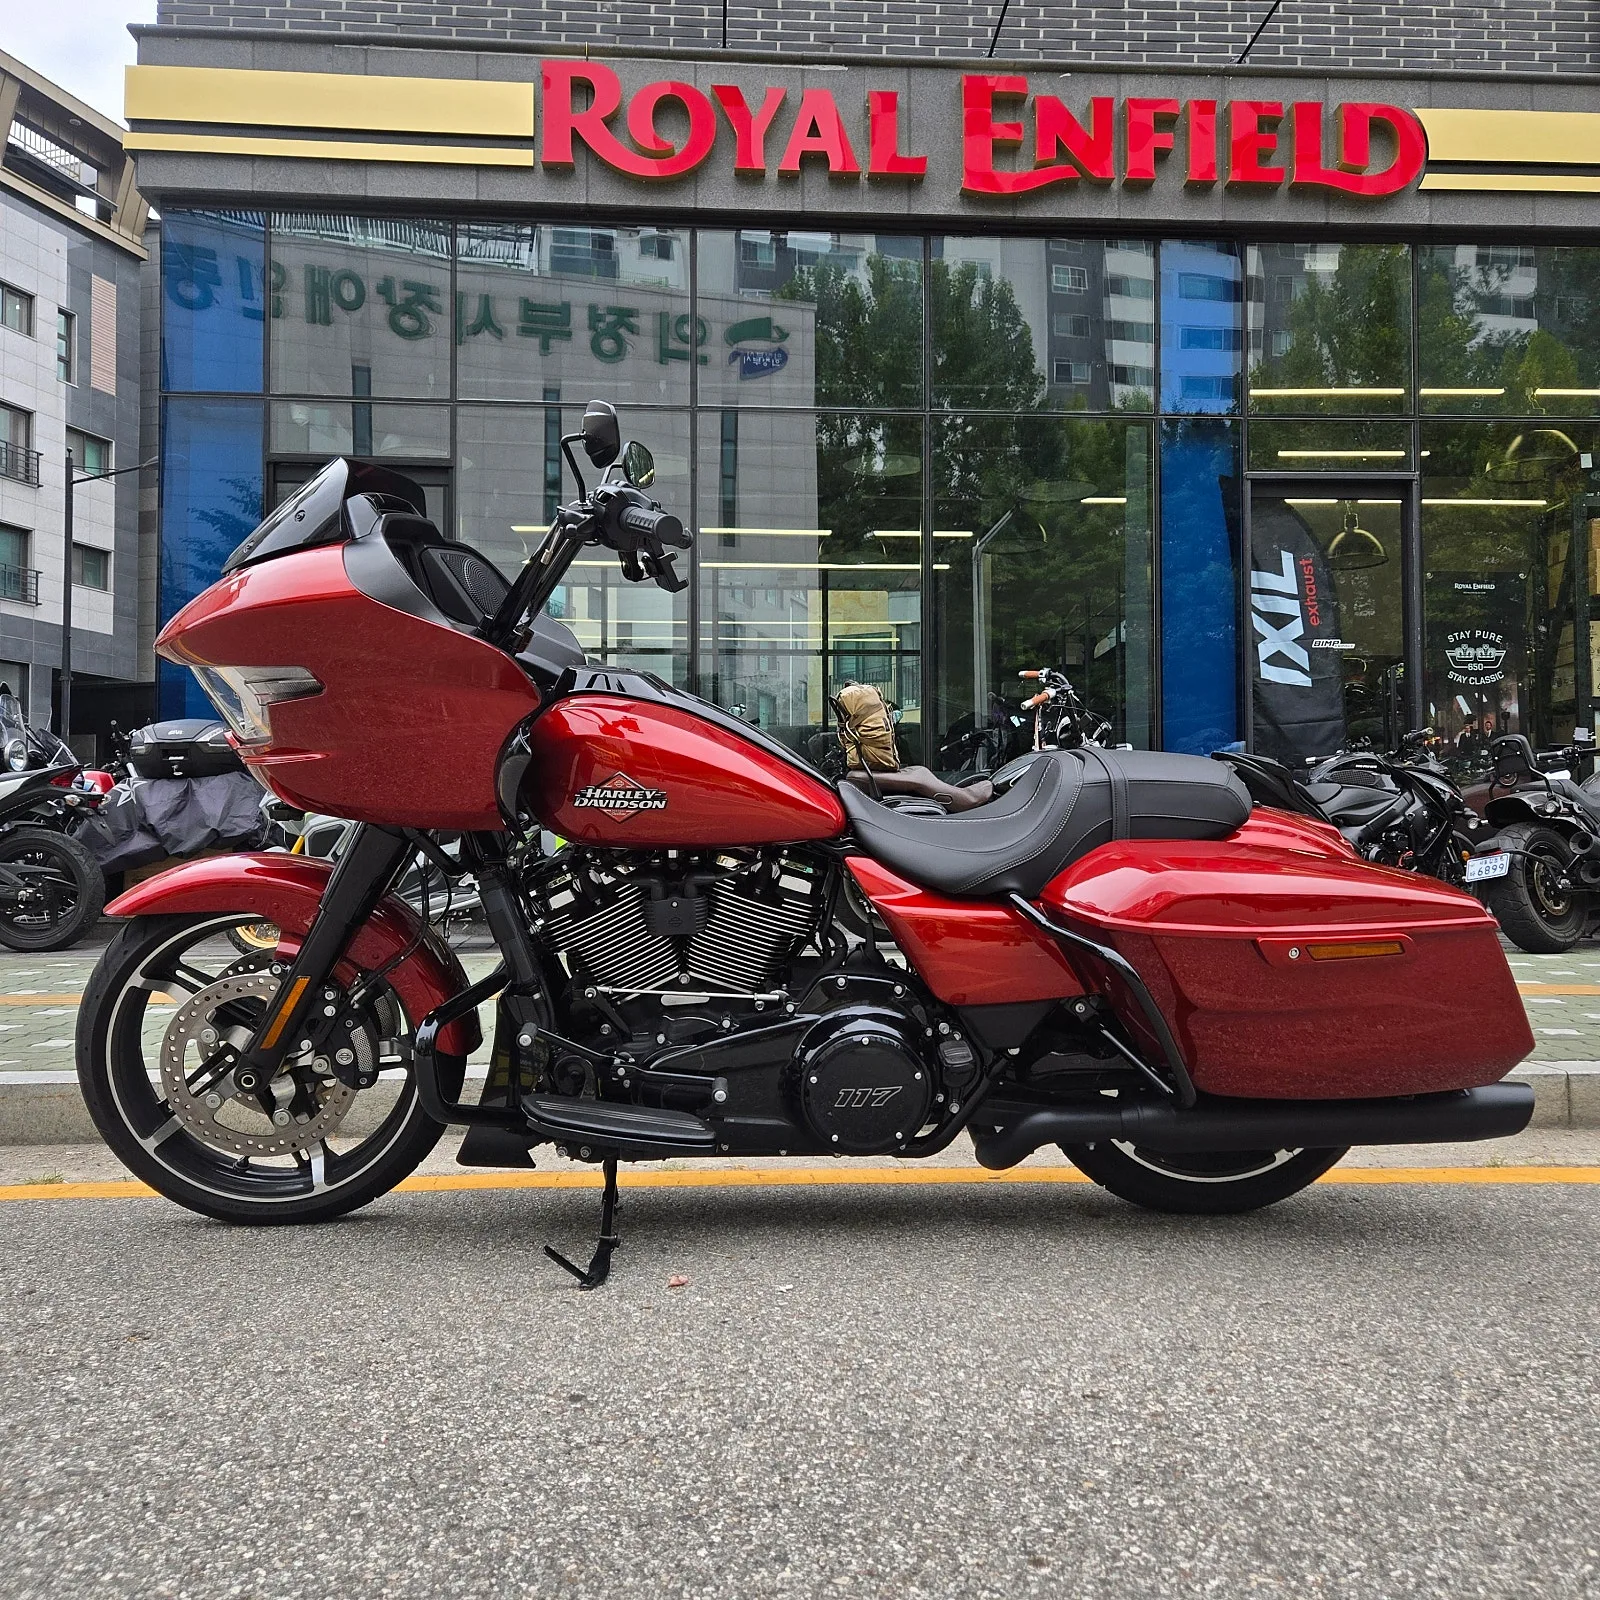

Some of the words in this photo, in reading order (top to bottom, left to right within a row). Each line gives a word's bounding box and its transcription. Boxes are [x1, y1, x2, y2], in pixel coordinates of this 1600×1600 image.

[541, 60, 928, 182] ROYAL
[960, 75, 1427, 197] ENFIELD
[1300, 558, 1320, 627] exhaust
[1250, 550, 1312, 687] IXIL
[1447, 630, 1471, 643] STAY
[1475, 630, 1503, 643] PURE
[1467, 663, 1484, 671] 650
[1447, 670, 1468, 684] STAY
[1468, 671, 1505, 685] CLASSIC
[586, 788, 656, 799] HARLEY
[573, 797, 667, 809] DAVIDSON
[1477, 863, 1504, 876] 6899
[834, 1086, 903, 1108] 117
